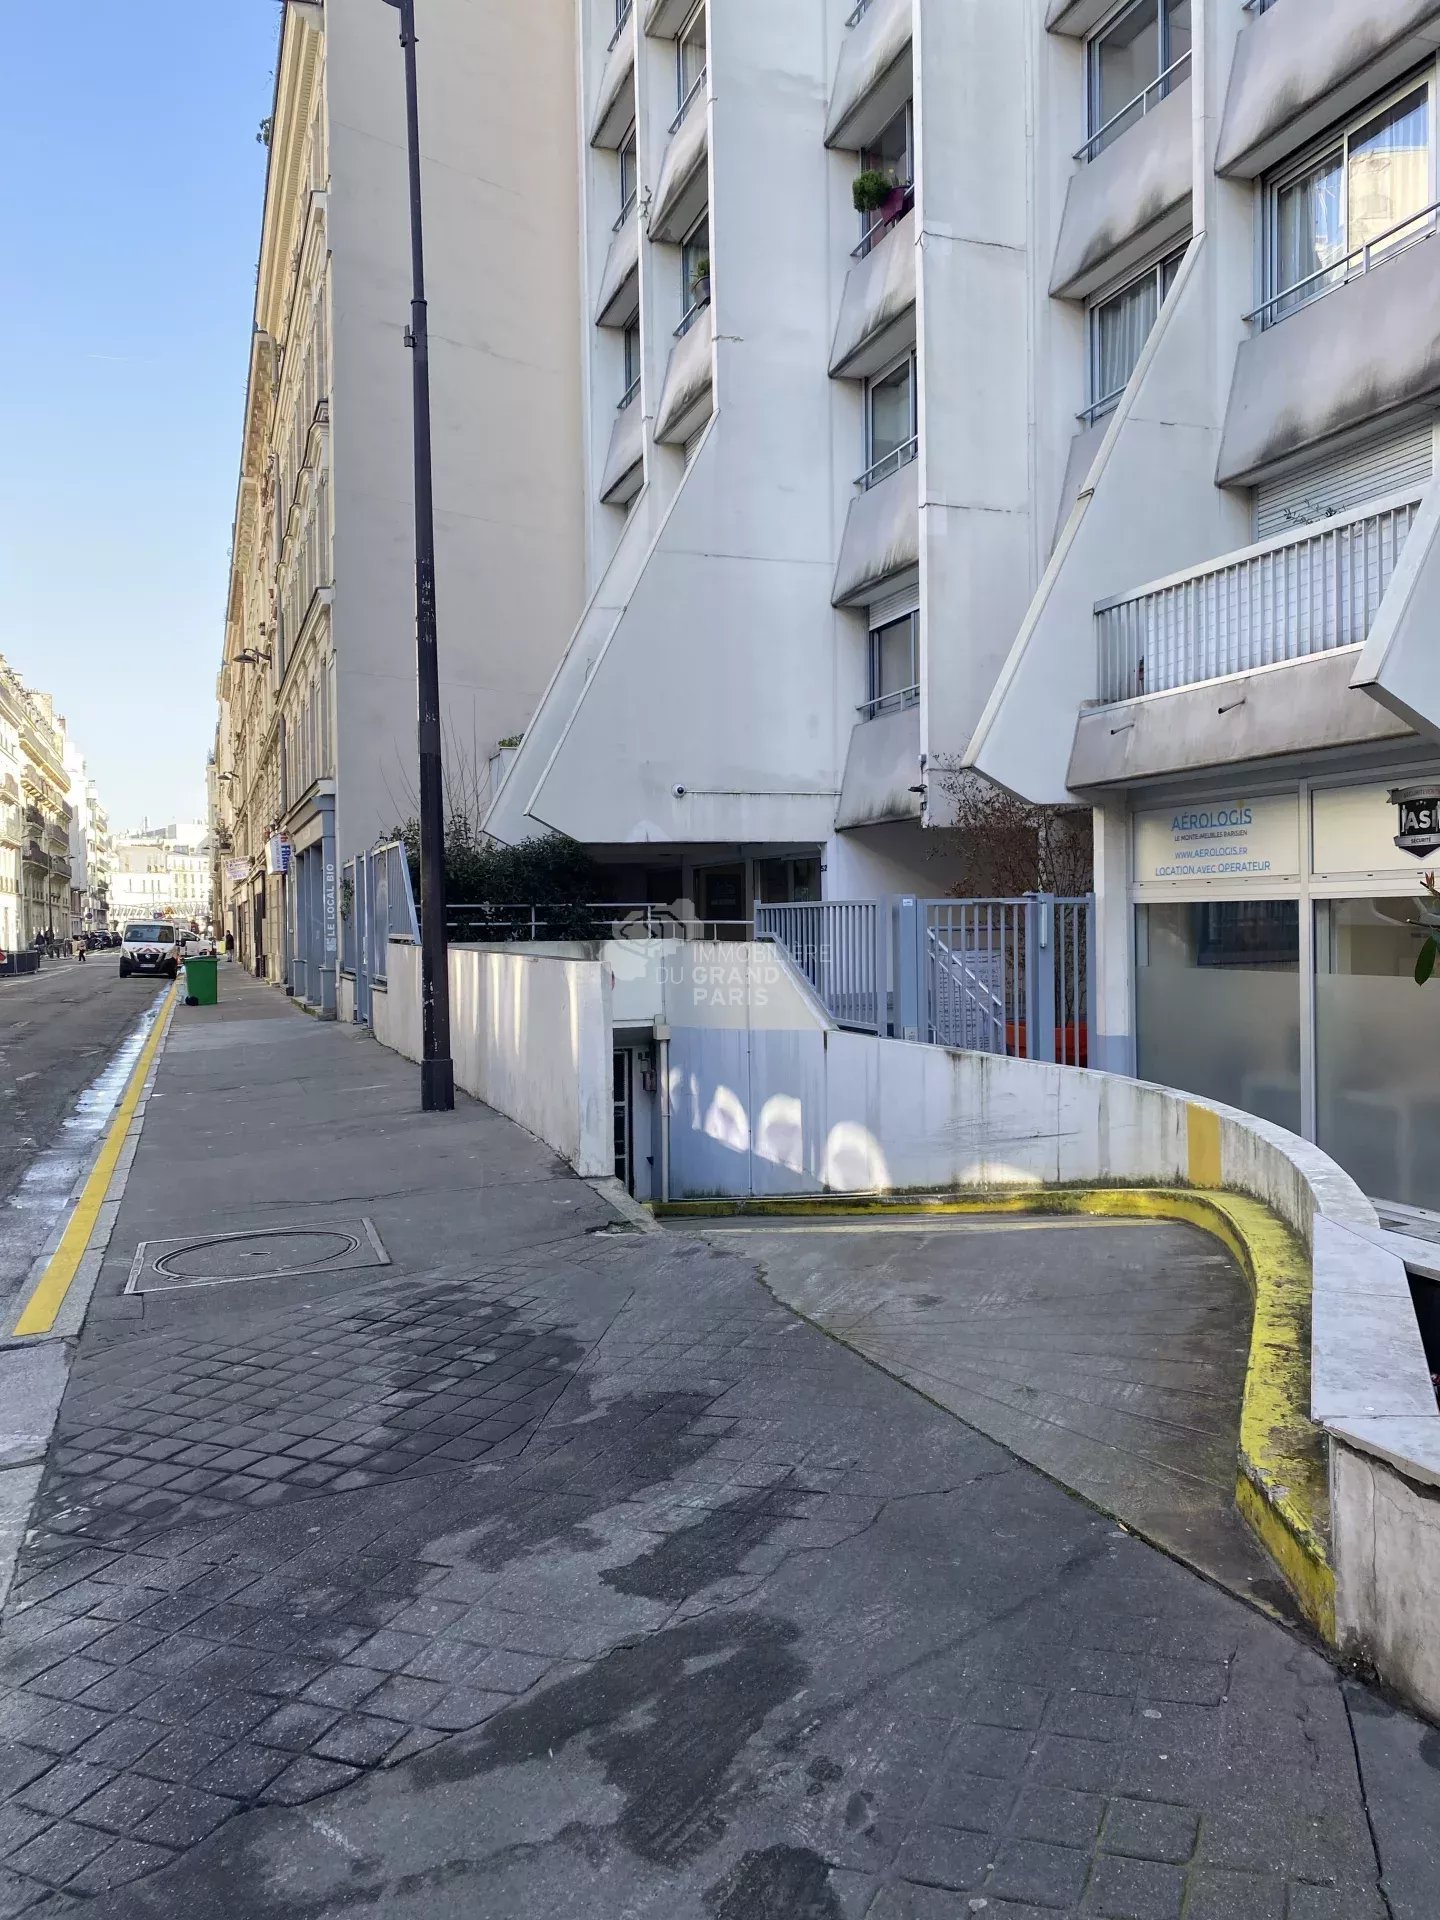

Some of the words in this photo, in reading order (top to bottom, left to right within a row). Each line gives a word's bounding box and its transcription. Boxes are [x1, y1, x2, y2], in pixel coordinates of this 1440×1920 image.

[1171, 808, 1252, 830] AÉROLOGIS
[326, 863, 335, 882] BIO
[1156, 865, 1194, 876] LOCATION
[1196, 865, 1215, 874] AVEC
[1218, 861, 1270, 872] OPERATEUR
[326, 885, 335, 920] LOCAL
[327, 924, 335, 936] LE
